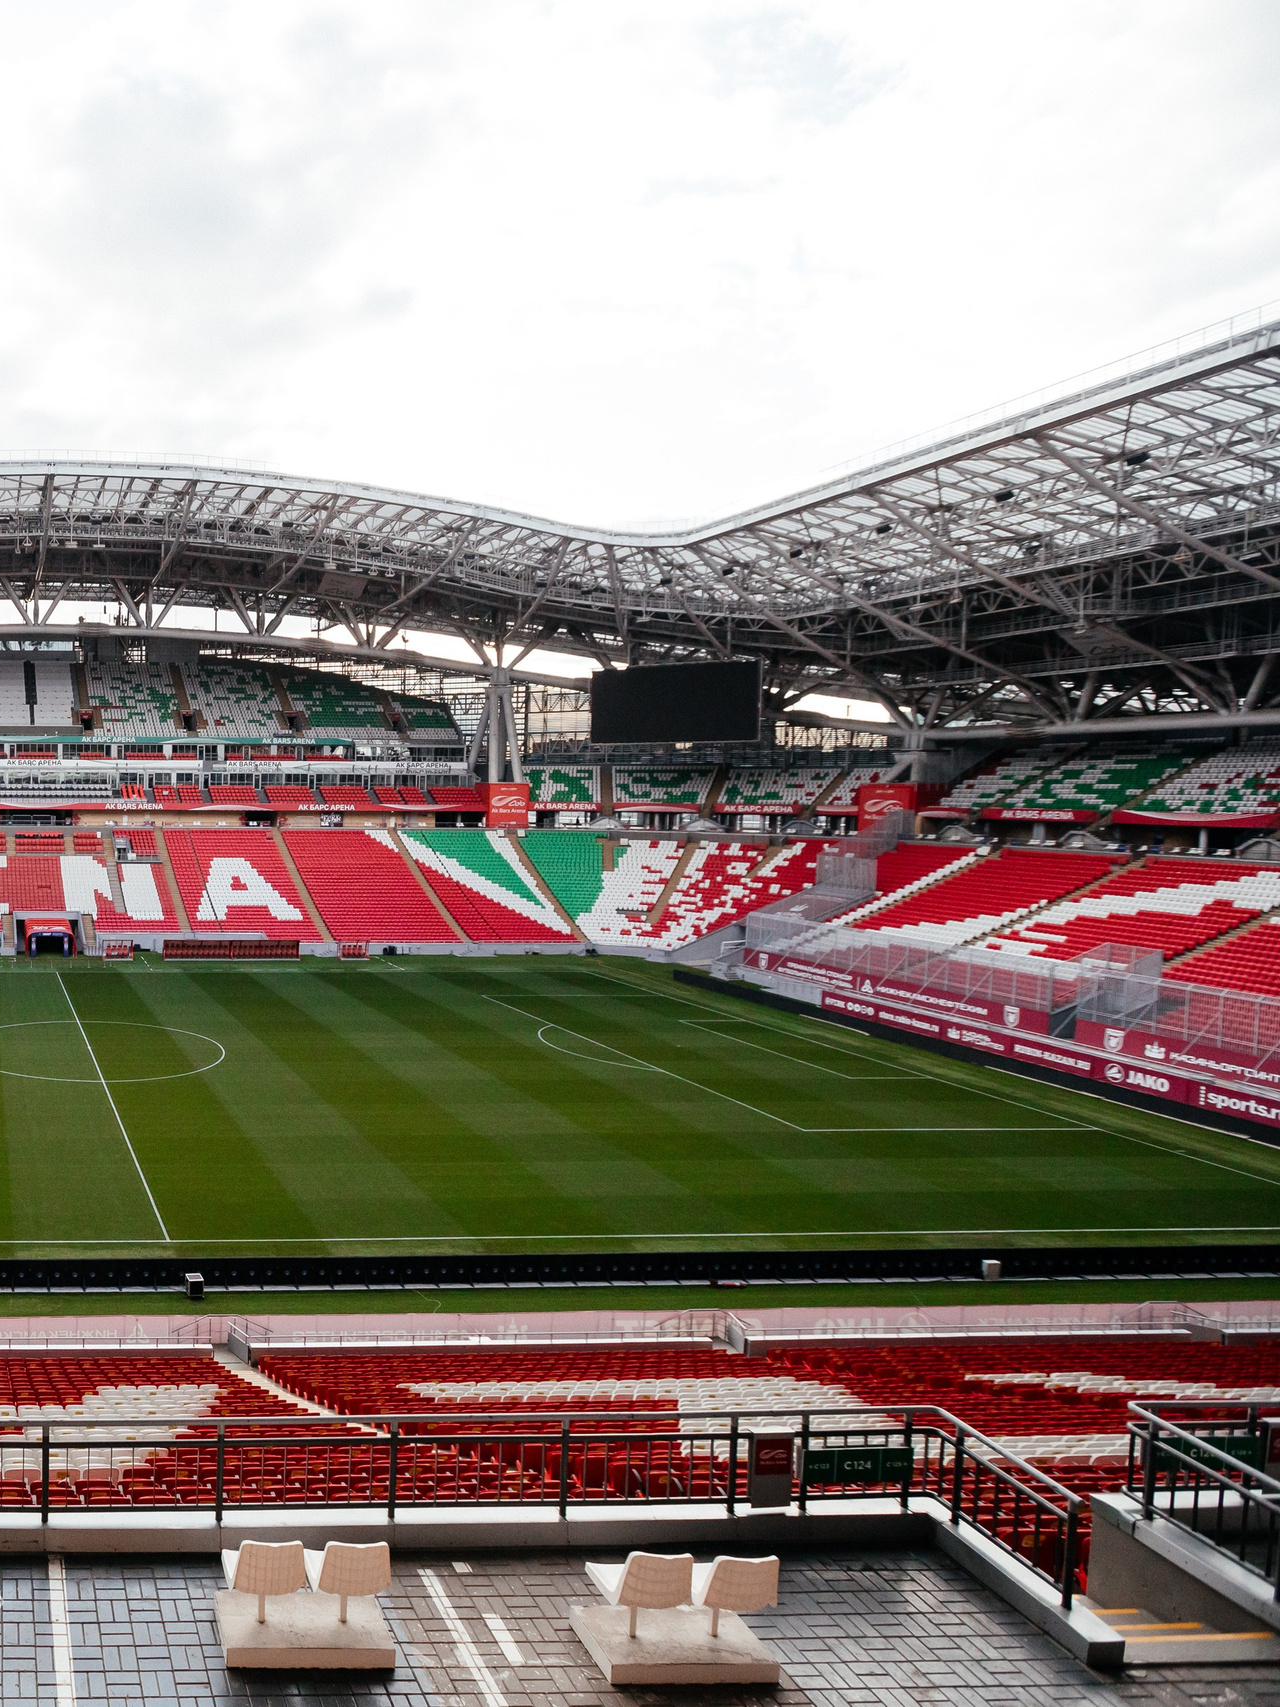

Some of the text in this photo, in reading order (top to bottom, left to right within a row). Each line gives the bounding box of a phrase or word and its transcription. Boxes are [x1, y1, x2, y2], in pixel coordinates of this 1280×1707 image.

[1001, 810, 1075, 820] AK BARS ARENA
[1125, 1071, 1170, 1092] JAKO
[1207, 1092, 1280, 1120] sports.r
[843, 1460, 872, 1470] C 124
